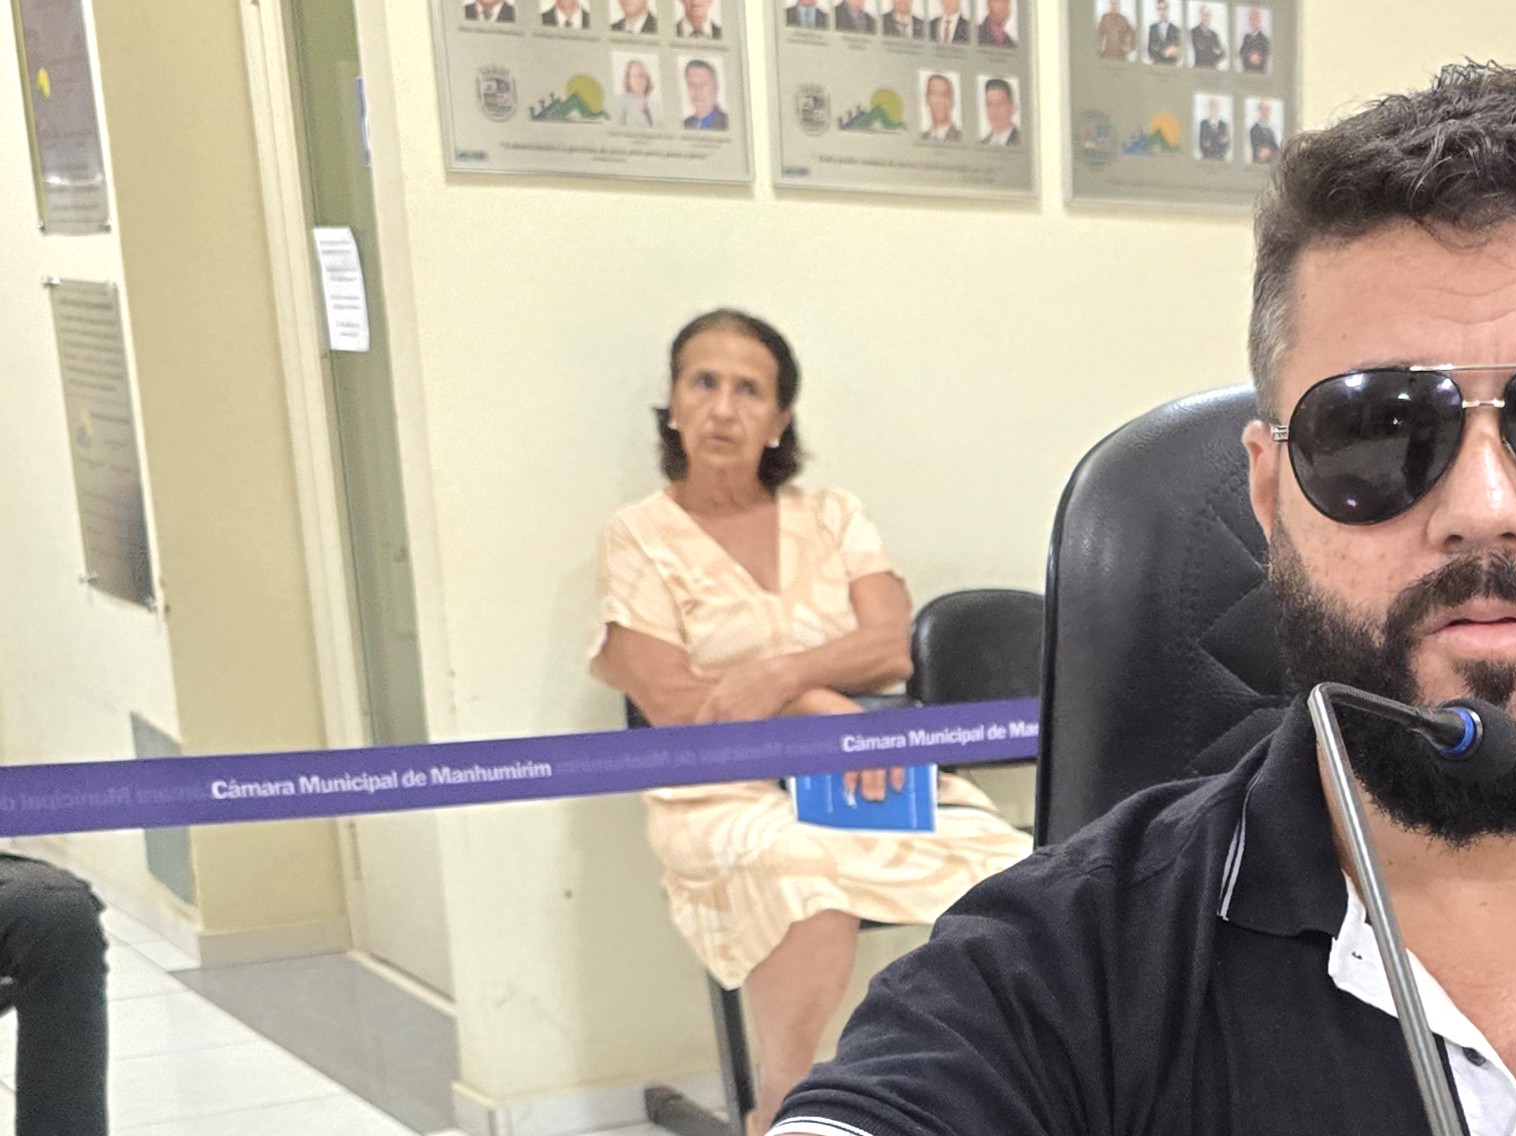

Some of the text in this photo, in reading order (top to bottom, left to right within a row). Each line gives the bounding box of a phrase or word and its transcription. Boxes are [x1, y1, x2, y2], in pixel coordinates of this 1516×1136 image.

[842, 732, 906, 752] Câmara
[908, 723, 984, 747] Municipal
[986, 723, 1007, 741] de
[211, 778, 295, 800] Câmara
[300, 770, 398, 794] Municipal
[402, 770, 427, 788] de
[430, 760, 553, 784] Manhumirim
